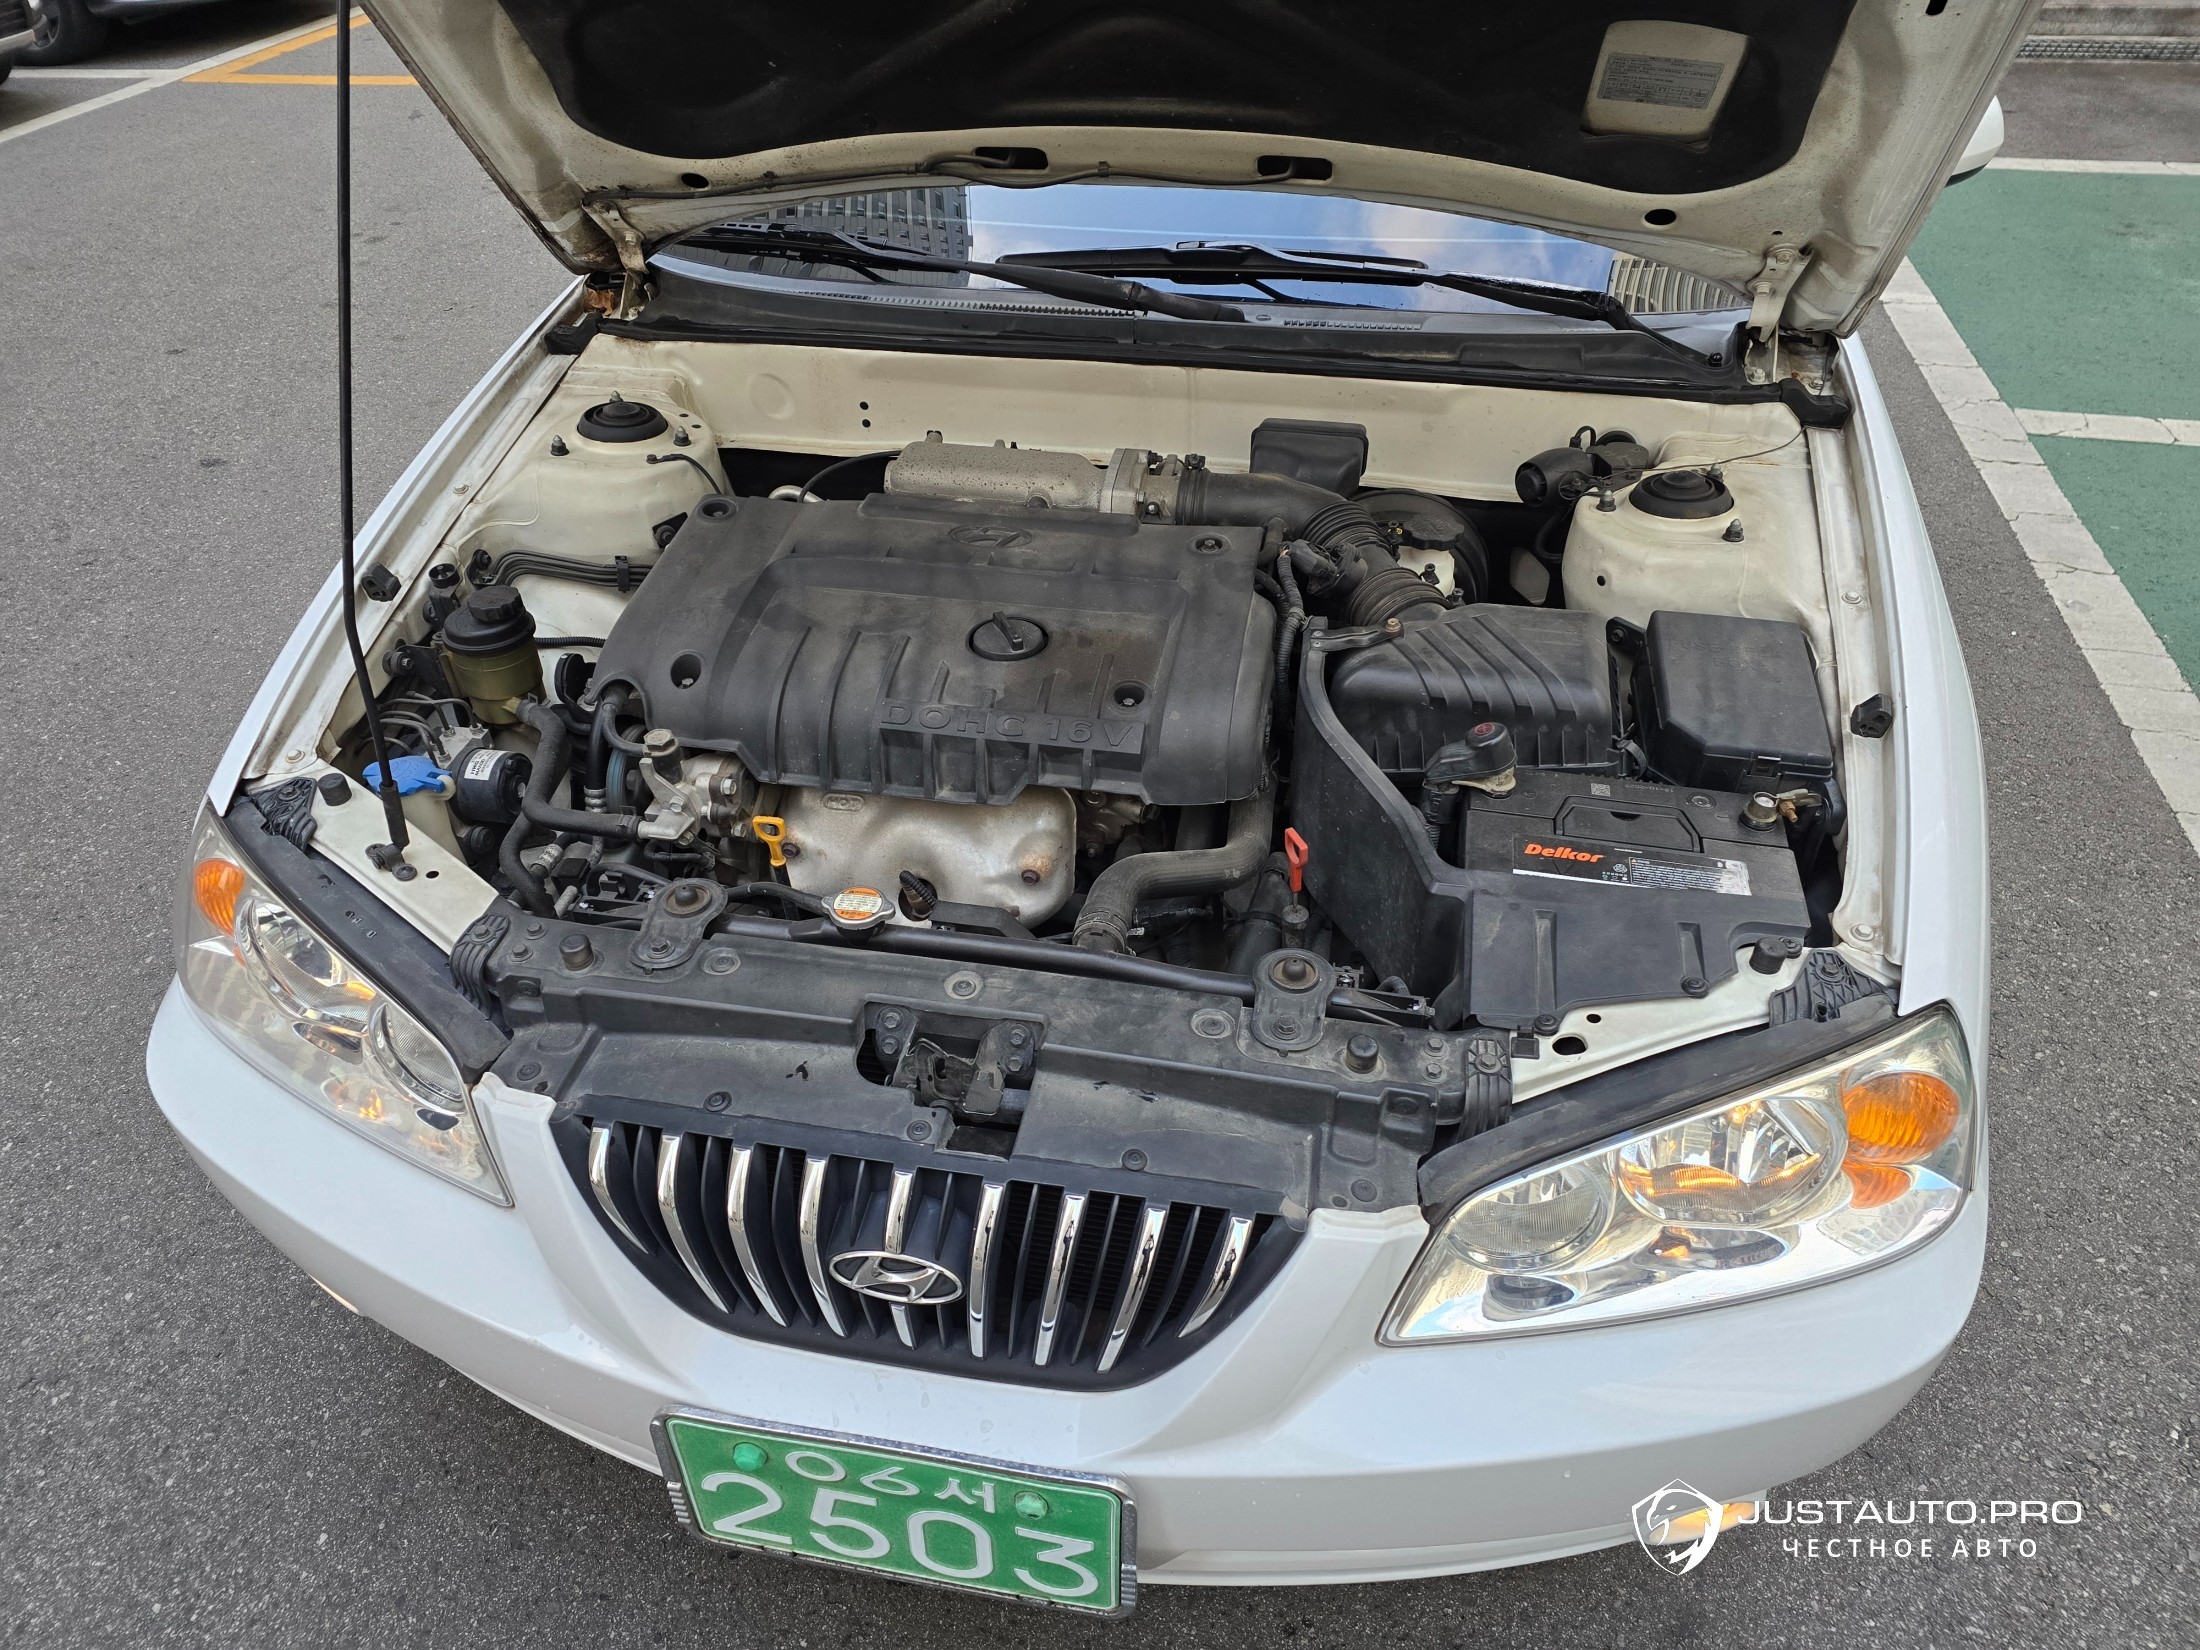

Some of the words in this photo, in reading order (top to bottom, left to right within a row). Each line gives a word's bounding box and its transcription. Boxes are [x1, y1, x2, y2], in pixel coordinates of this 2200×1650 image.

[881, 705, 1026, 738] DOHC
[1046, 718, 1134, 747] 16V
[1524, 843, 1605, 863] Delkor
[784, 1450, 996, 1514] 06서
[701, 1472, 1099, 1597] 2503
